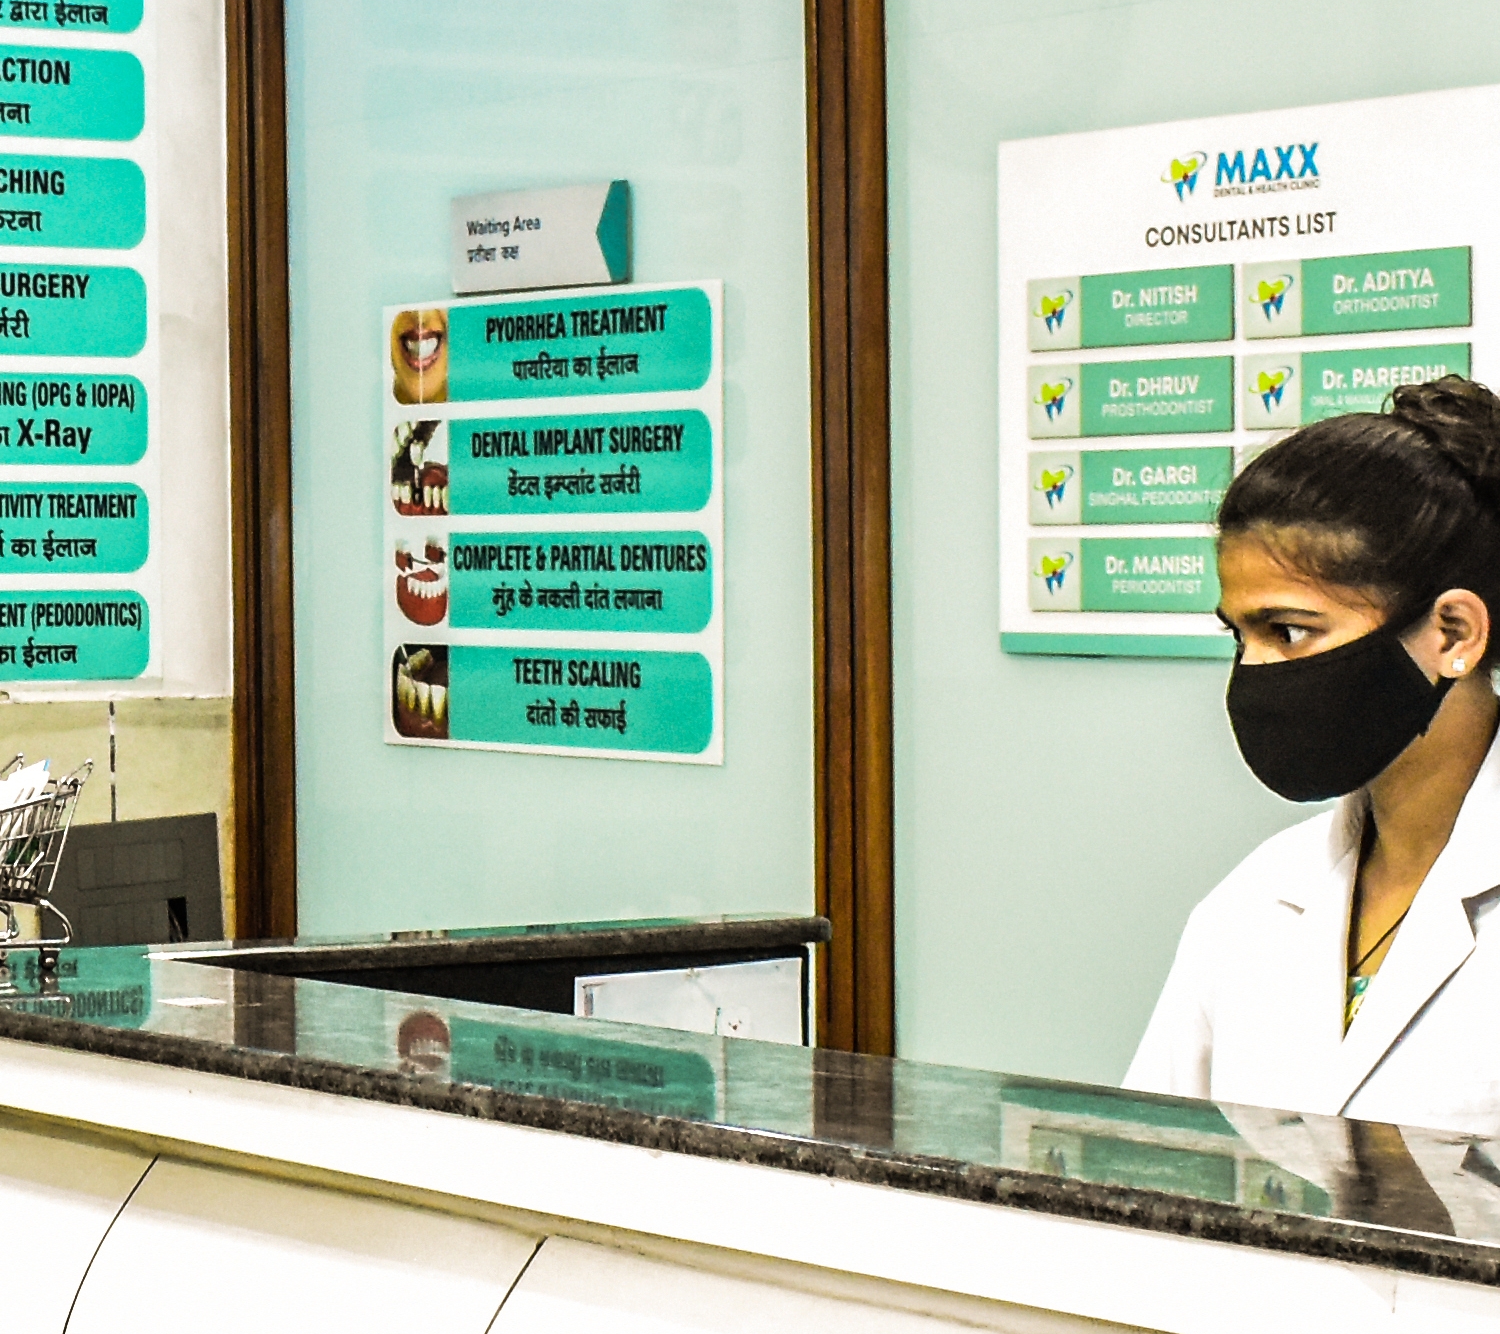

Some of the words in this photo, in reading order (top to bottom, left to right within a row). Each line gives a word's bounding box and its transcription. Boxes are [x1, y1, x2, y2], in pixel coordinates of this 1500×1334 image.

[1216, 143, 1318, 185] MAXX
[467, 219, 509, 237] Waiting
[513, 215, 540, 231] Area
[1146, 216, 1289, 247] CONSULTANTS
[1297, 211, 1336, 235] LIST
[1333, 274, 1358, 295] Dr.
[1363, 268, 1434, 292] ADITYA
[1112, 290, 1134, 309] Dr.
[1140, 285, 1198, 307] NITISH
[486, 313, 566, 343] PYORRHEA
[570, 305, 667, 337] TREATMENT
[32, 382, 71, 411] (OPG
[76, 382, 87, 408] &
[92, 383, 134, 413] IOPA)
[1110, 379, 1132, 399] Dr.
[1137, 375, 1199, 397] DHRUV
[17, 418, 92, 454] X-Ray
[472, 431, 529, 458] DENTAL
[534, 427, 605, 456] IMPLANT
[609, 424, 684, 453] SURGERY
[1113, 467, 1136, 486] Dr.
[1140, 465, 1197, 486] GARGI
[47, 494, 137, 519] TREATMENT
[454, 545, 532, 571] COMPLETE
[536, 545, 546, 571] &
[551, 544, 616, 571] PARTIAL
[621, 544, 707, 572] DENTURES
[1106, 555, 1128, 575] Dr.
[1133, 555, 1205, 575] MANISH
[31, 602, 141, 631] (PEDODONTICS)
[512, 657, 563, 685] TEETH
[568, 660, 641, 688] SCALING
